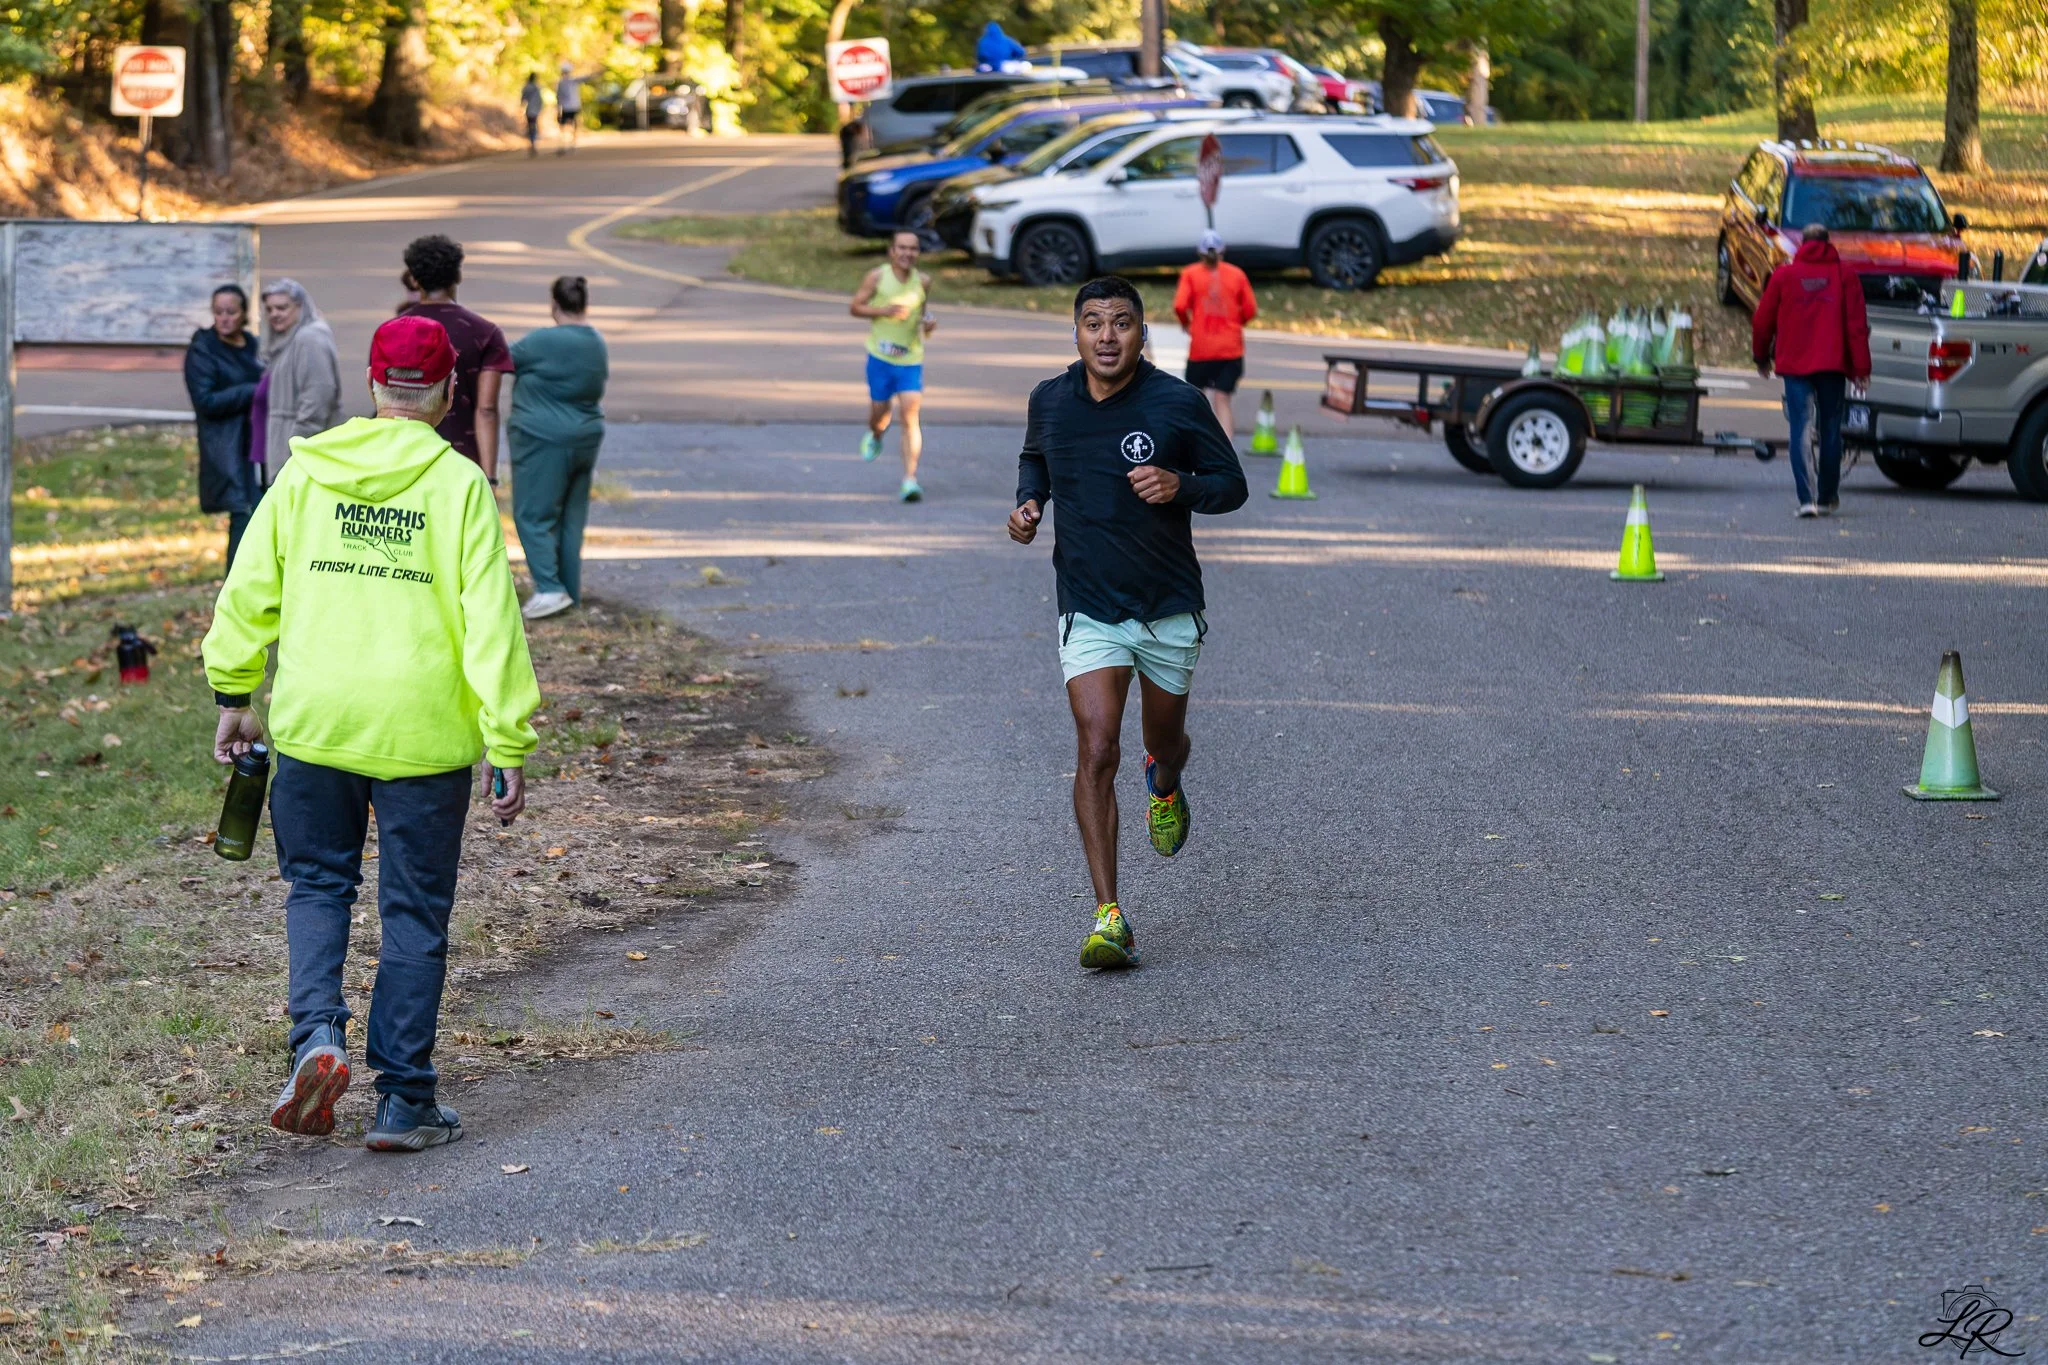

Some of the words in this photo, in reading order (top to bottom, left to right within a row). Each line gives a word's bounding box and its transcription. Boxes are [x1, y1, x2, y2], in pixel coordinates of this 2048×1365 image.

[335, 502, 426, 531] MEMPHIS
[341, 521, 413, 542] RUNNERS
[343, 543, 367, 552] TRACK
[393, 549, 413, 557] CLUB
[309, 560, 356, 574] FINISH
[358, 564, 390, 578] LINE
[391, 568, 434, 584] CREW
